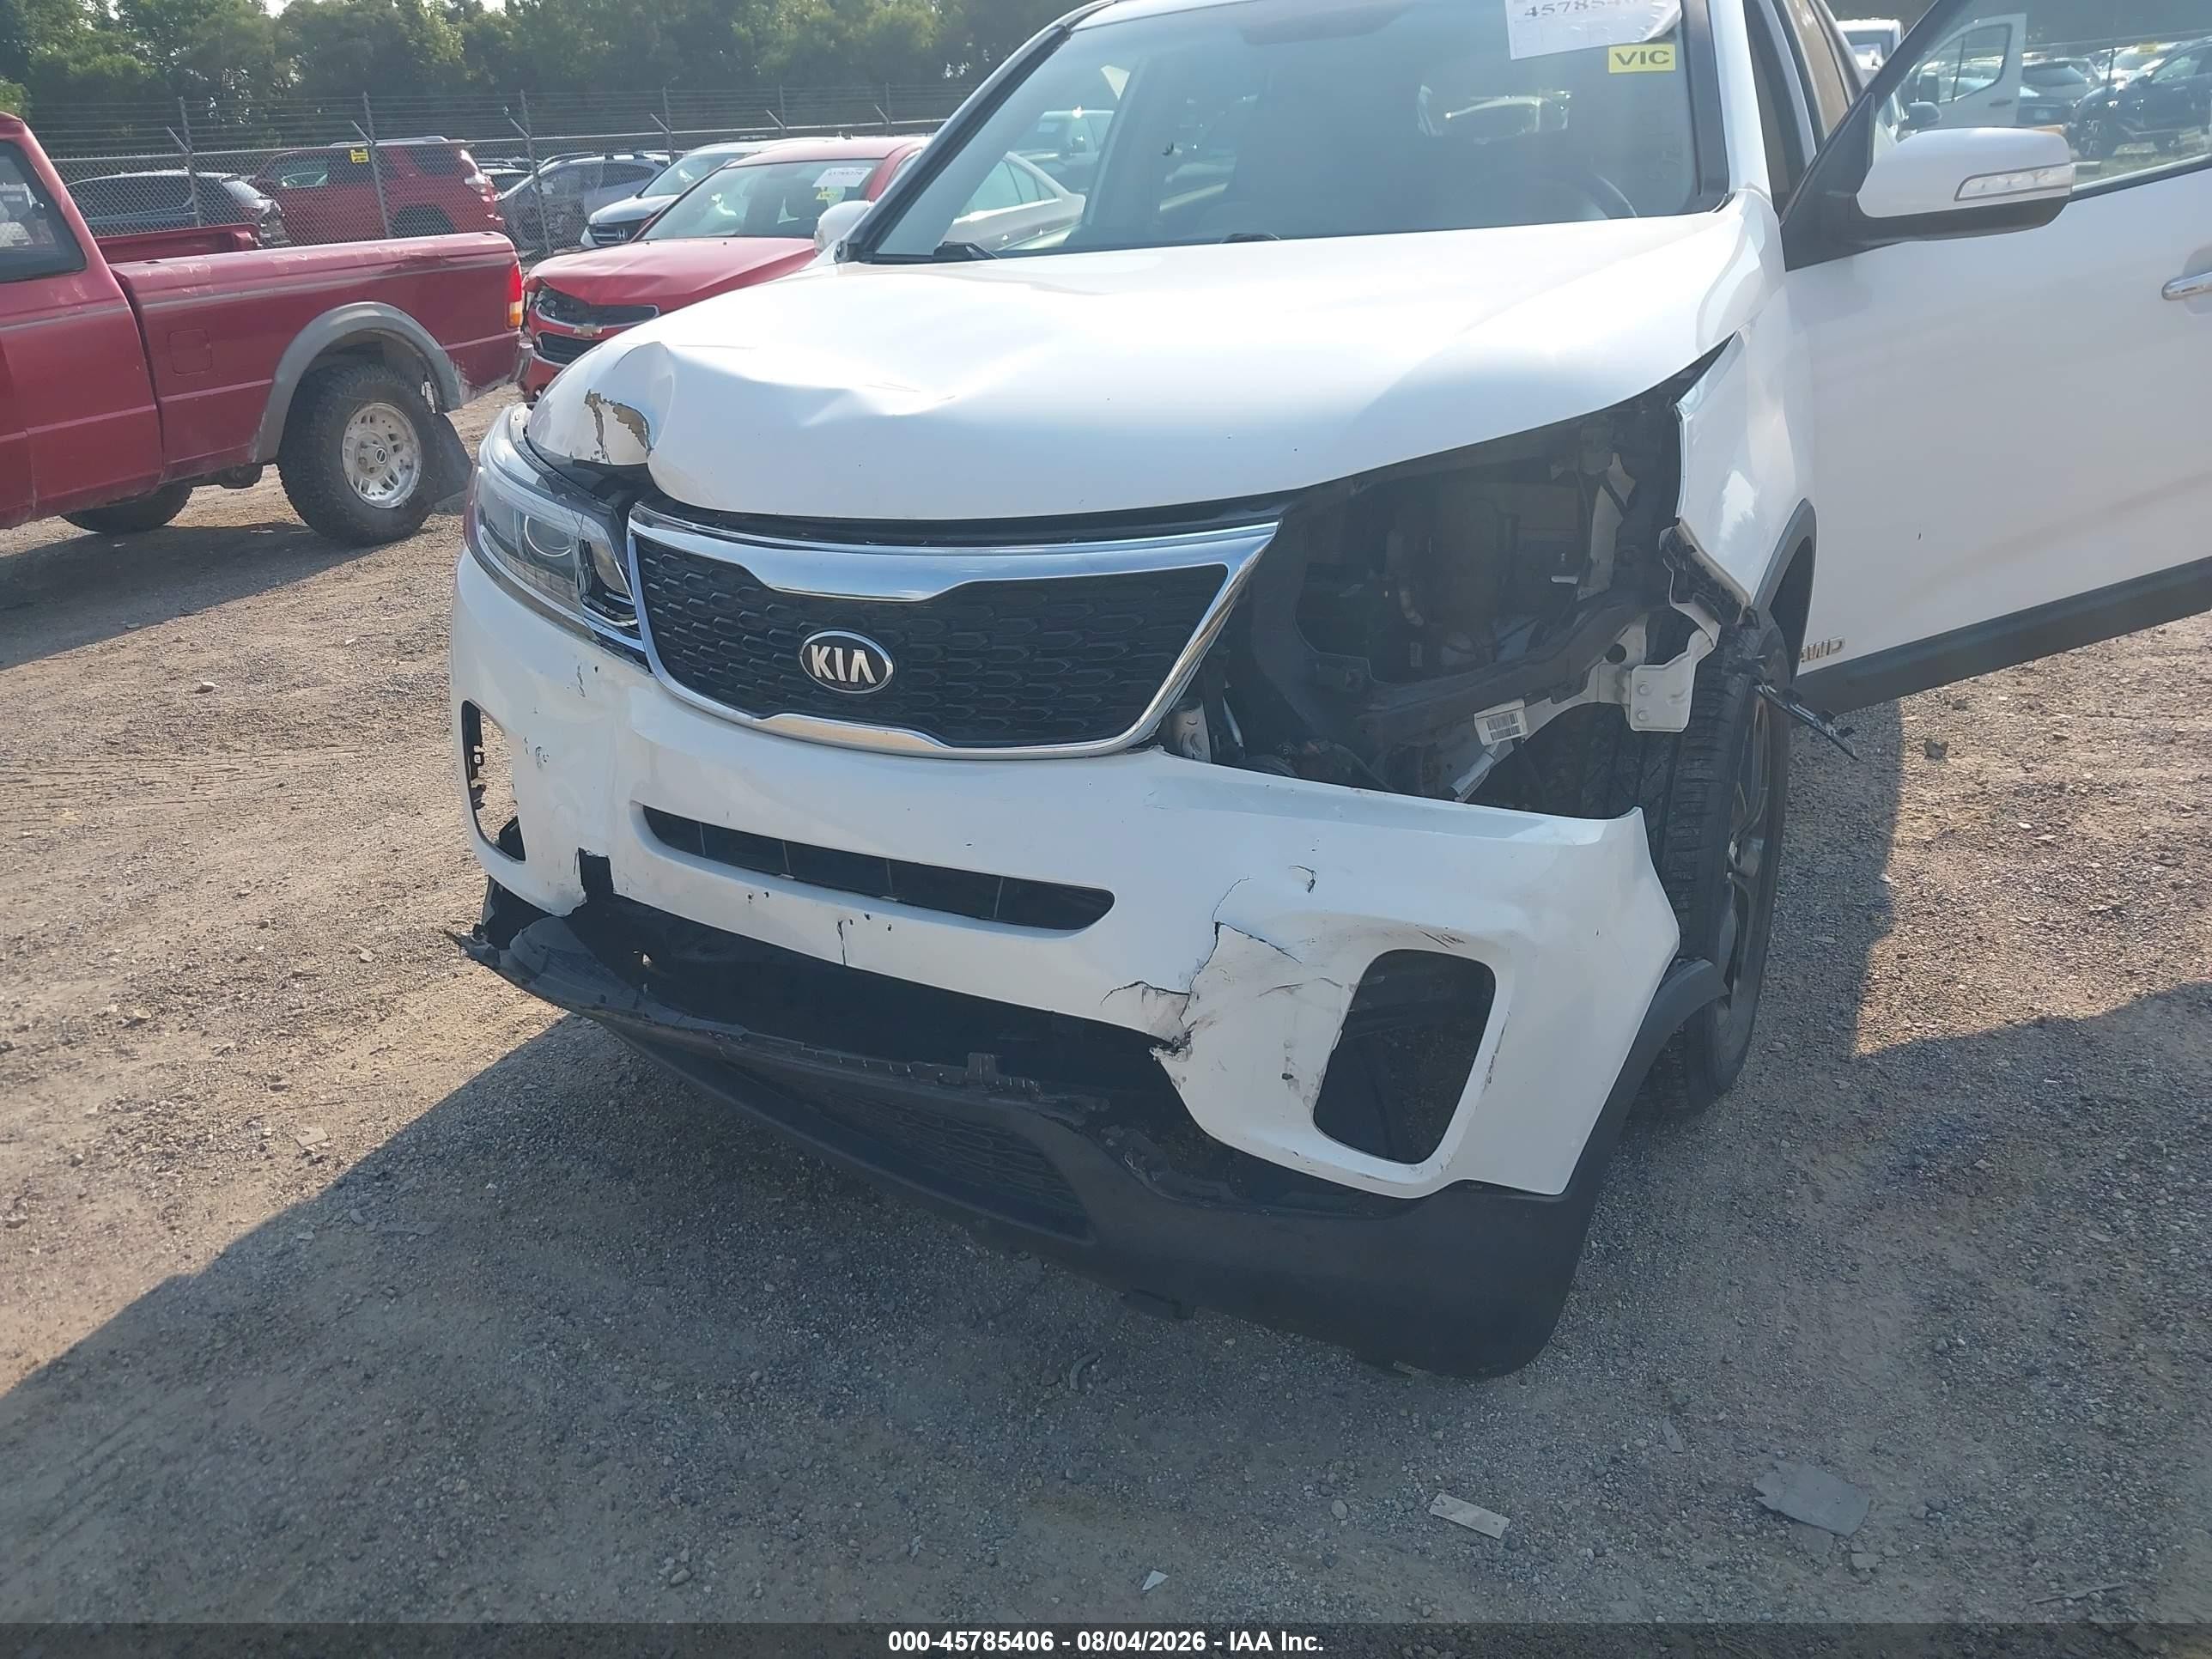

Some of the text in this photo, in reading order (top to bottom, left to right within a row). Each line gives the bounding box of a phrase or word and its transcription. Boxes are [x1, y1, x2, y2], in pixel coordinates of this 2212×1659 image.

[1524, 0, 1638, 17] 45785
[1614, 50, 1669, 66] VIC
[811, 644, 878, 684] KIA
